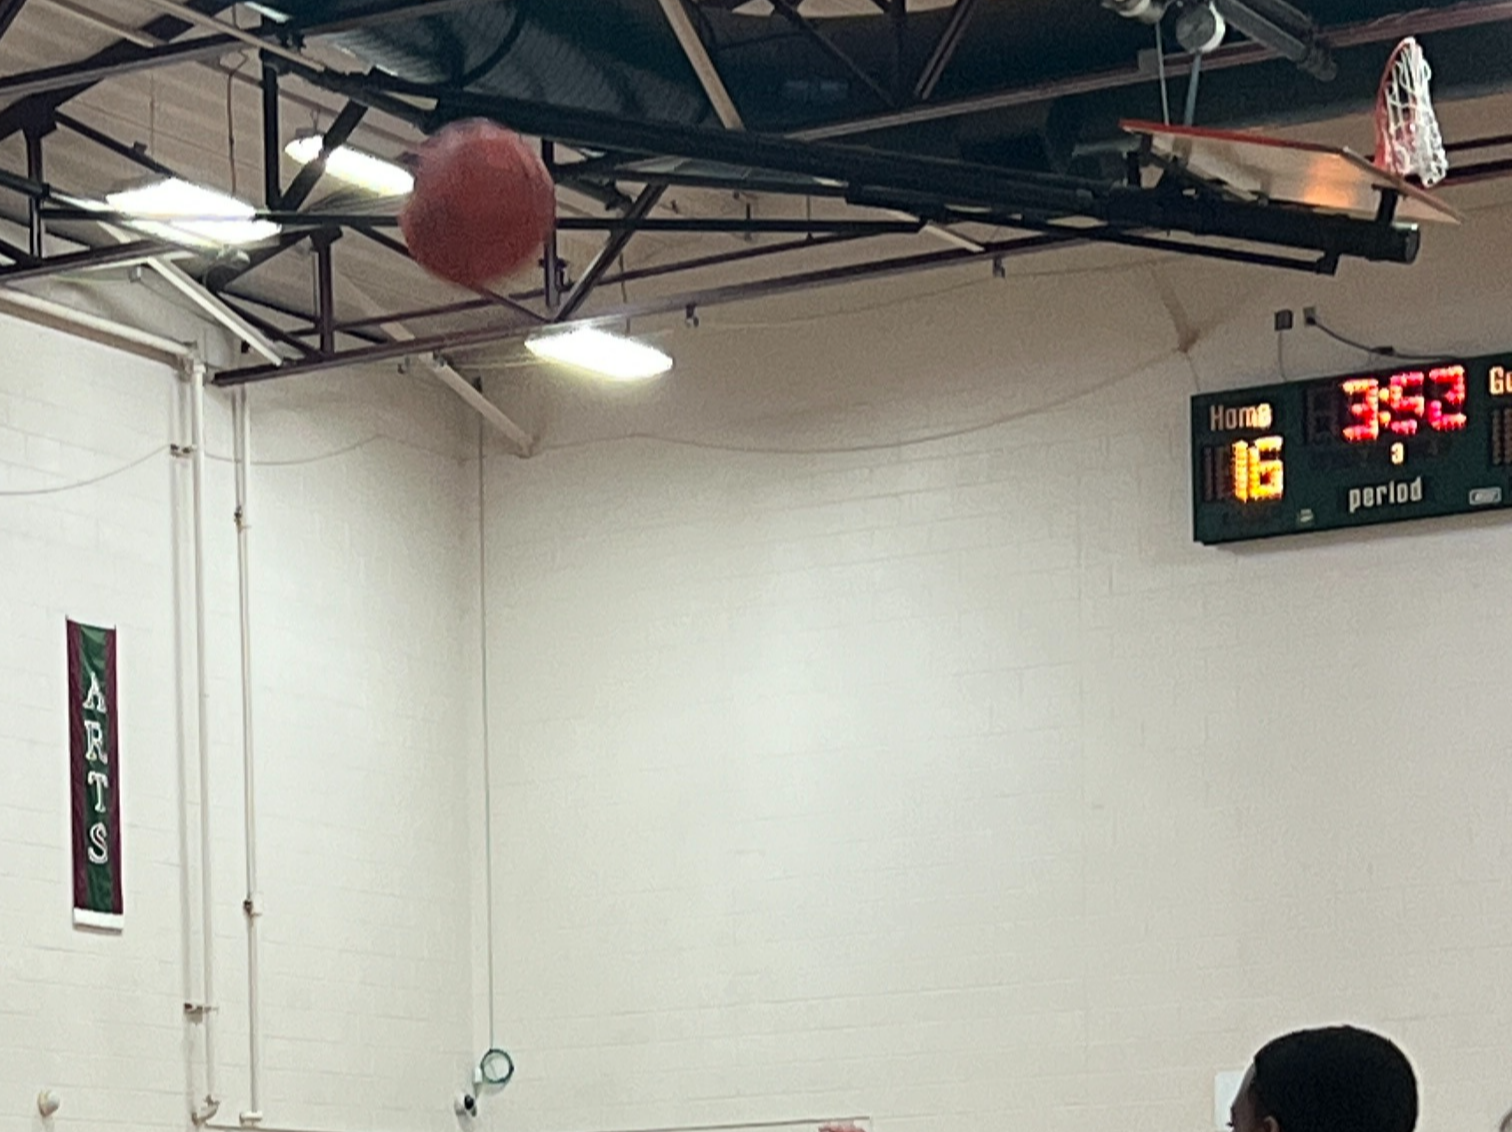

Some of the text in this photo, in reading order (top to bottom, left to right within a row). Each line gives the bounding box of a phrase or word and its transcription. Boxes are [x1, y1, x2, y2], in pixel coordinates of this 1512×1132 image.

[1210, 403, 1273, 431] Home
[1233, 436, 1284, 503] 16
[1349, 477, 1423, 513] period
[82, 672, 109, 865] ARTS
